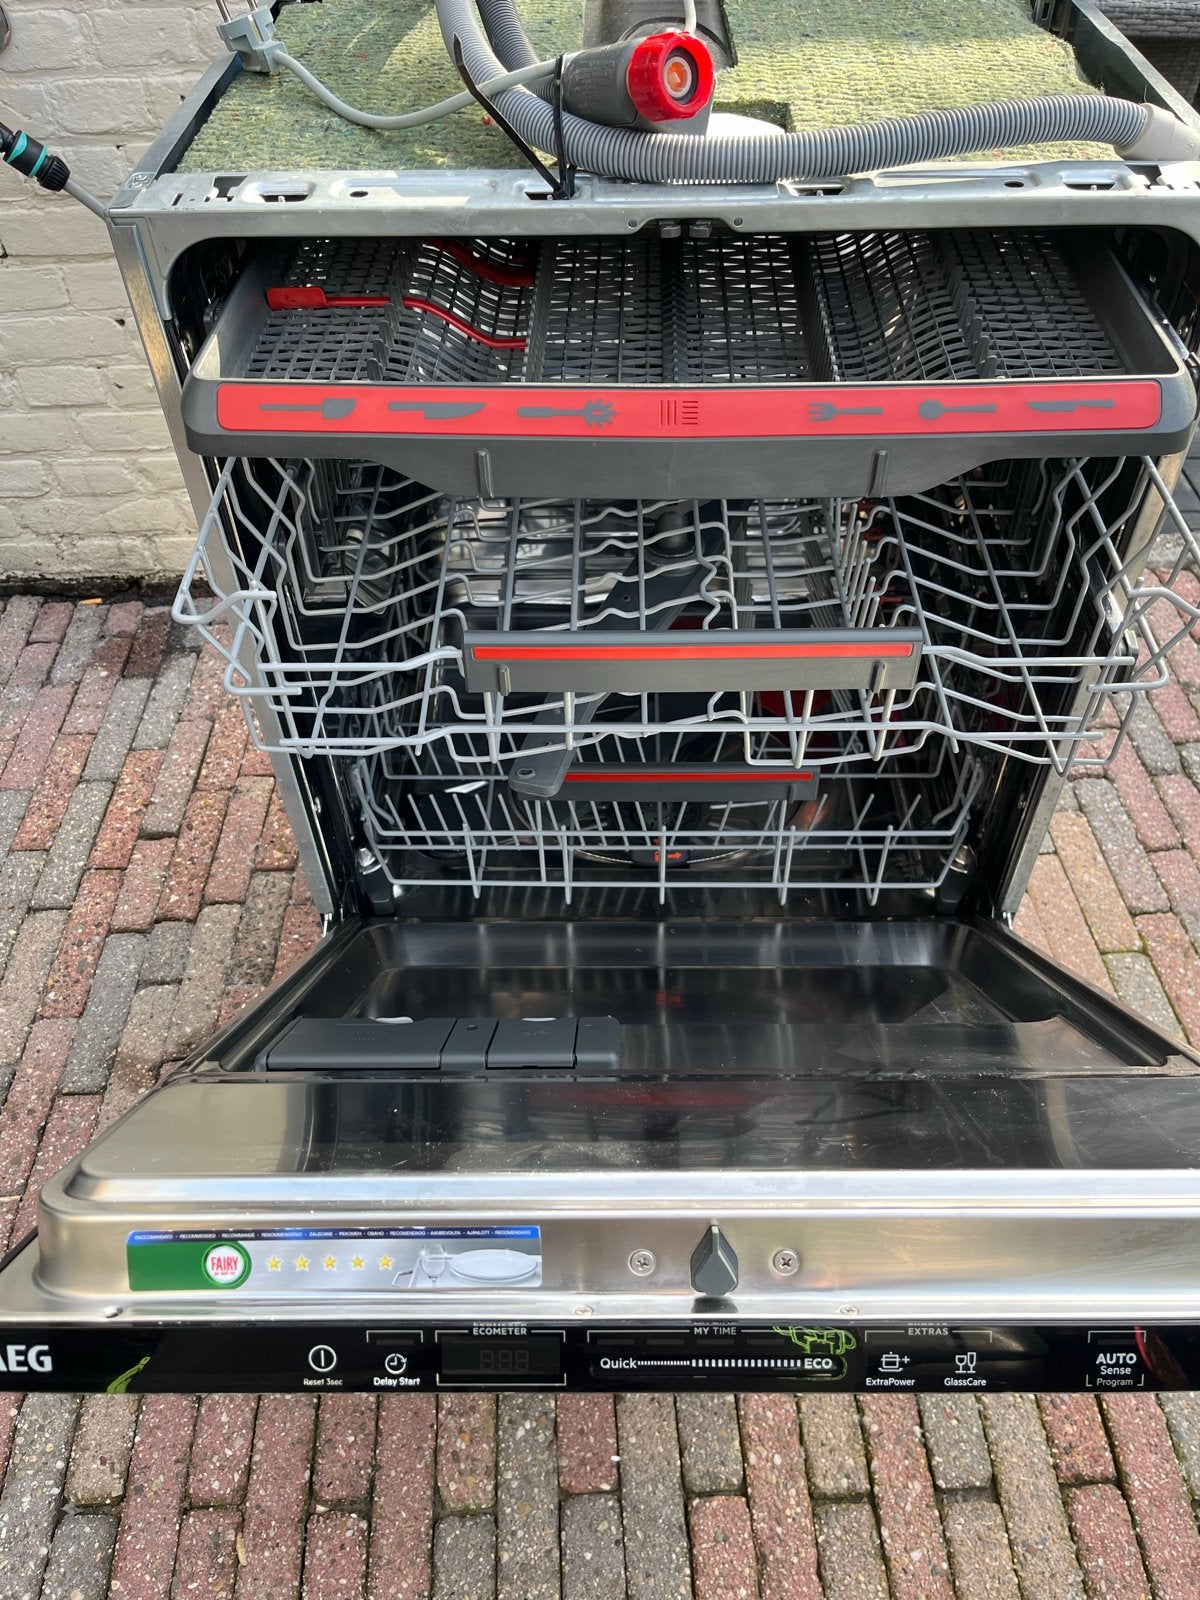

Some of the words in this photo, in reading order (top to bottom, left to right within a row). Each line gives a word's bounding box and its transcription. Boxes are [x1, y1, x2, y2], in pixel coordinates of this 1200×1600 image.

[210, 1256, 239, 1271] FAIRY
[472, 1327, 528, 1336] ECOMETER
[693, 1327, 709, 1336] MY
[712, 1327, 737, 1336] TIME
[907, 1327, 949, 1336] EXTRAS
[600, 1357, 638, 1369] Quick
[803, 1357, 833, 1370] ECO
[1095, 1352, 1137, 1365] AUTO
[1100, 1365, 1132, 1375] Sense
[303, 1377, 325, 1387] Reset
[326, 1377, 343, 1387] 3sec
[372, 1376, 398, 1388] Delay
[399, 1376, 421, 1386] Start
[865, 1377, 916, 1387] ExtraPower
[943, 1377, 987, 1387] GlassCare
[1096, 1377, 1134, 1388] Program
